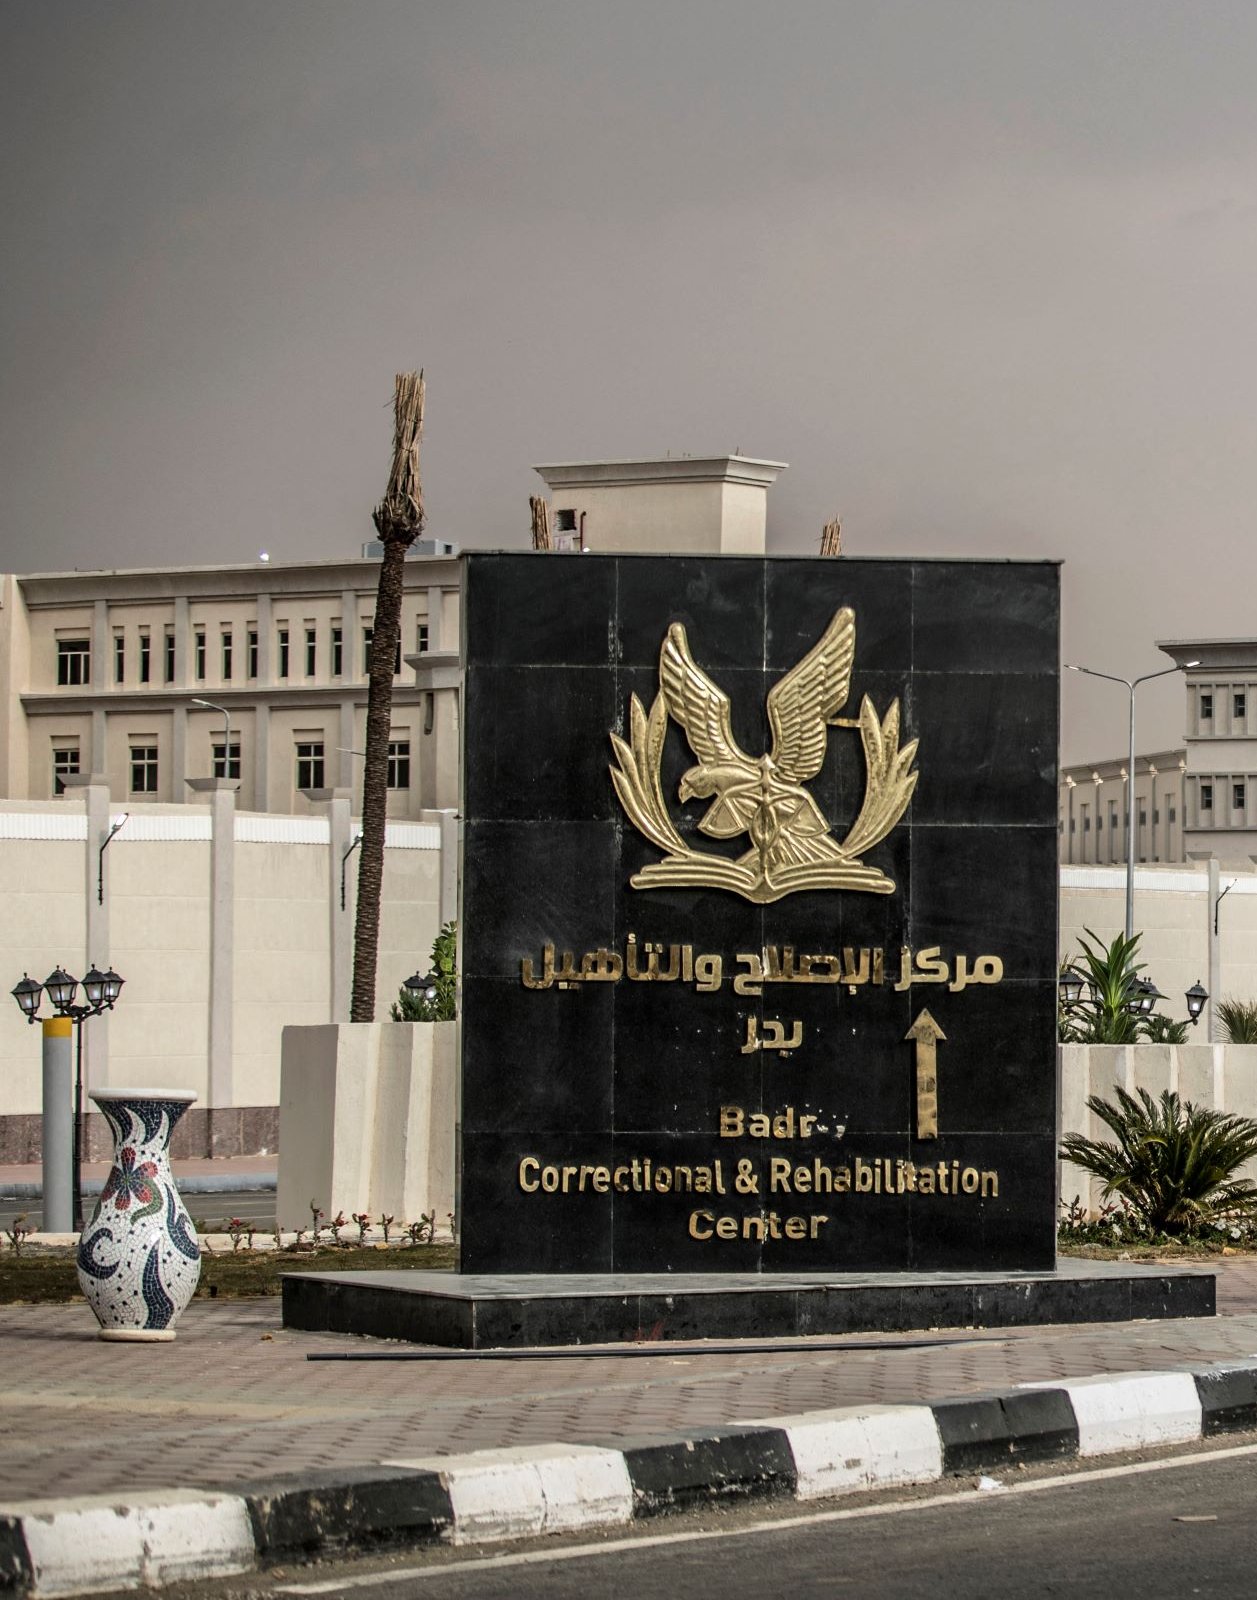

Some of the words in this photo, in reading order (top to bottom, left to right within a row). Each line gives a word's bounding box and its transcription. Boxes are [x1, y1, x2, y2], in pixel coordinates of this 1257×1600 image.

[522, 932, 722, 993] والتأهيل
[895, 945, 1004, 992] مركز
[741, 1013, 803, 1058] بدر
[719, 1105, 818, 1139] Badr
[519, 1156, 726, 1195] Correctional
[735, 1157, 760, 1195] &
[770, 1157, 999, 1198] Rehabilitation
[688, 1210, 829, 1241] Center
